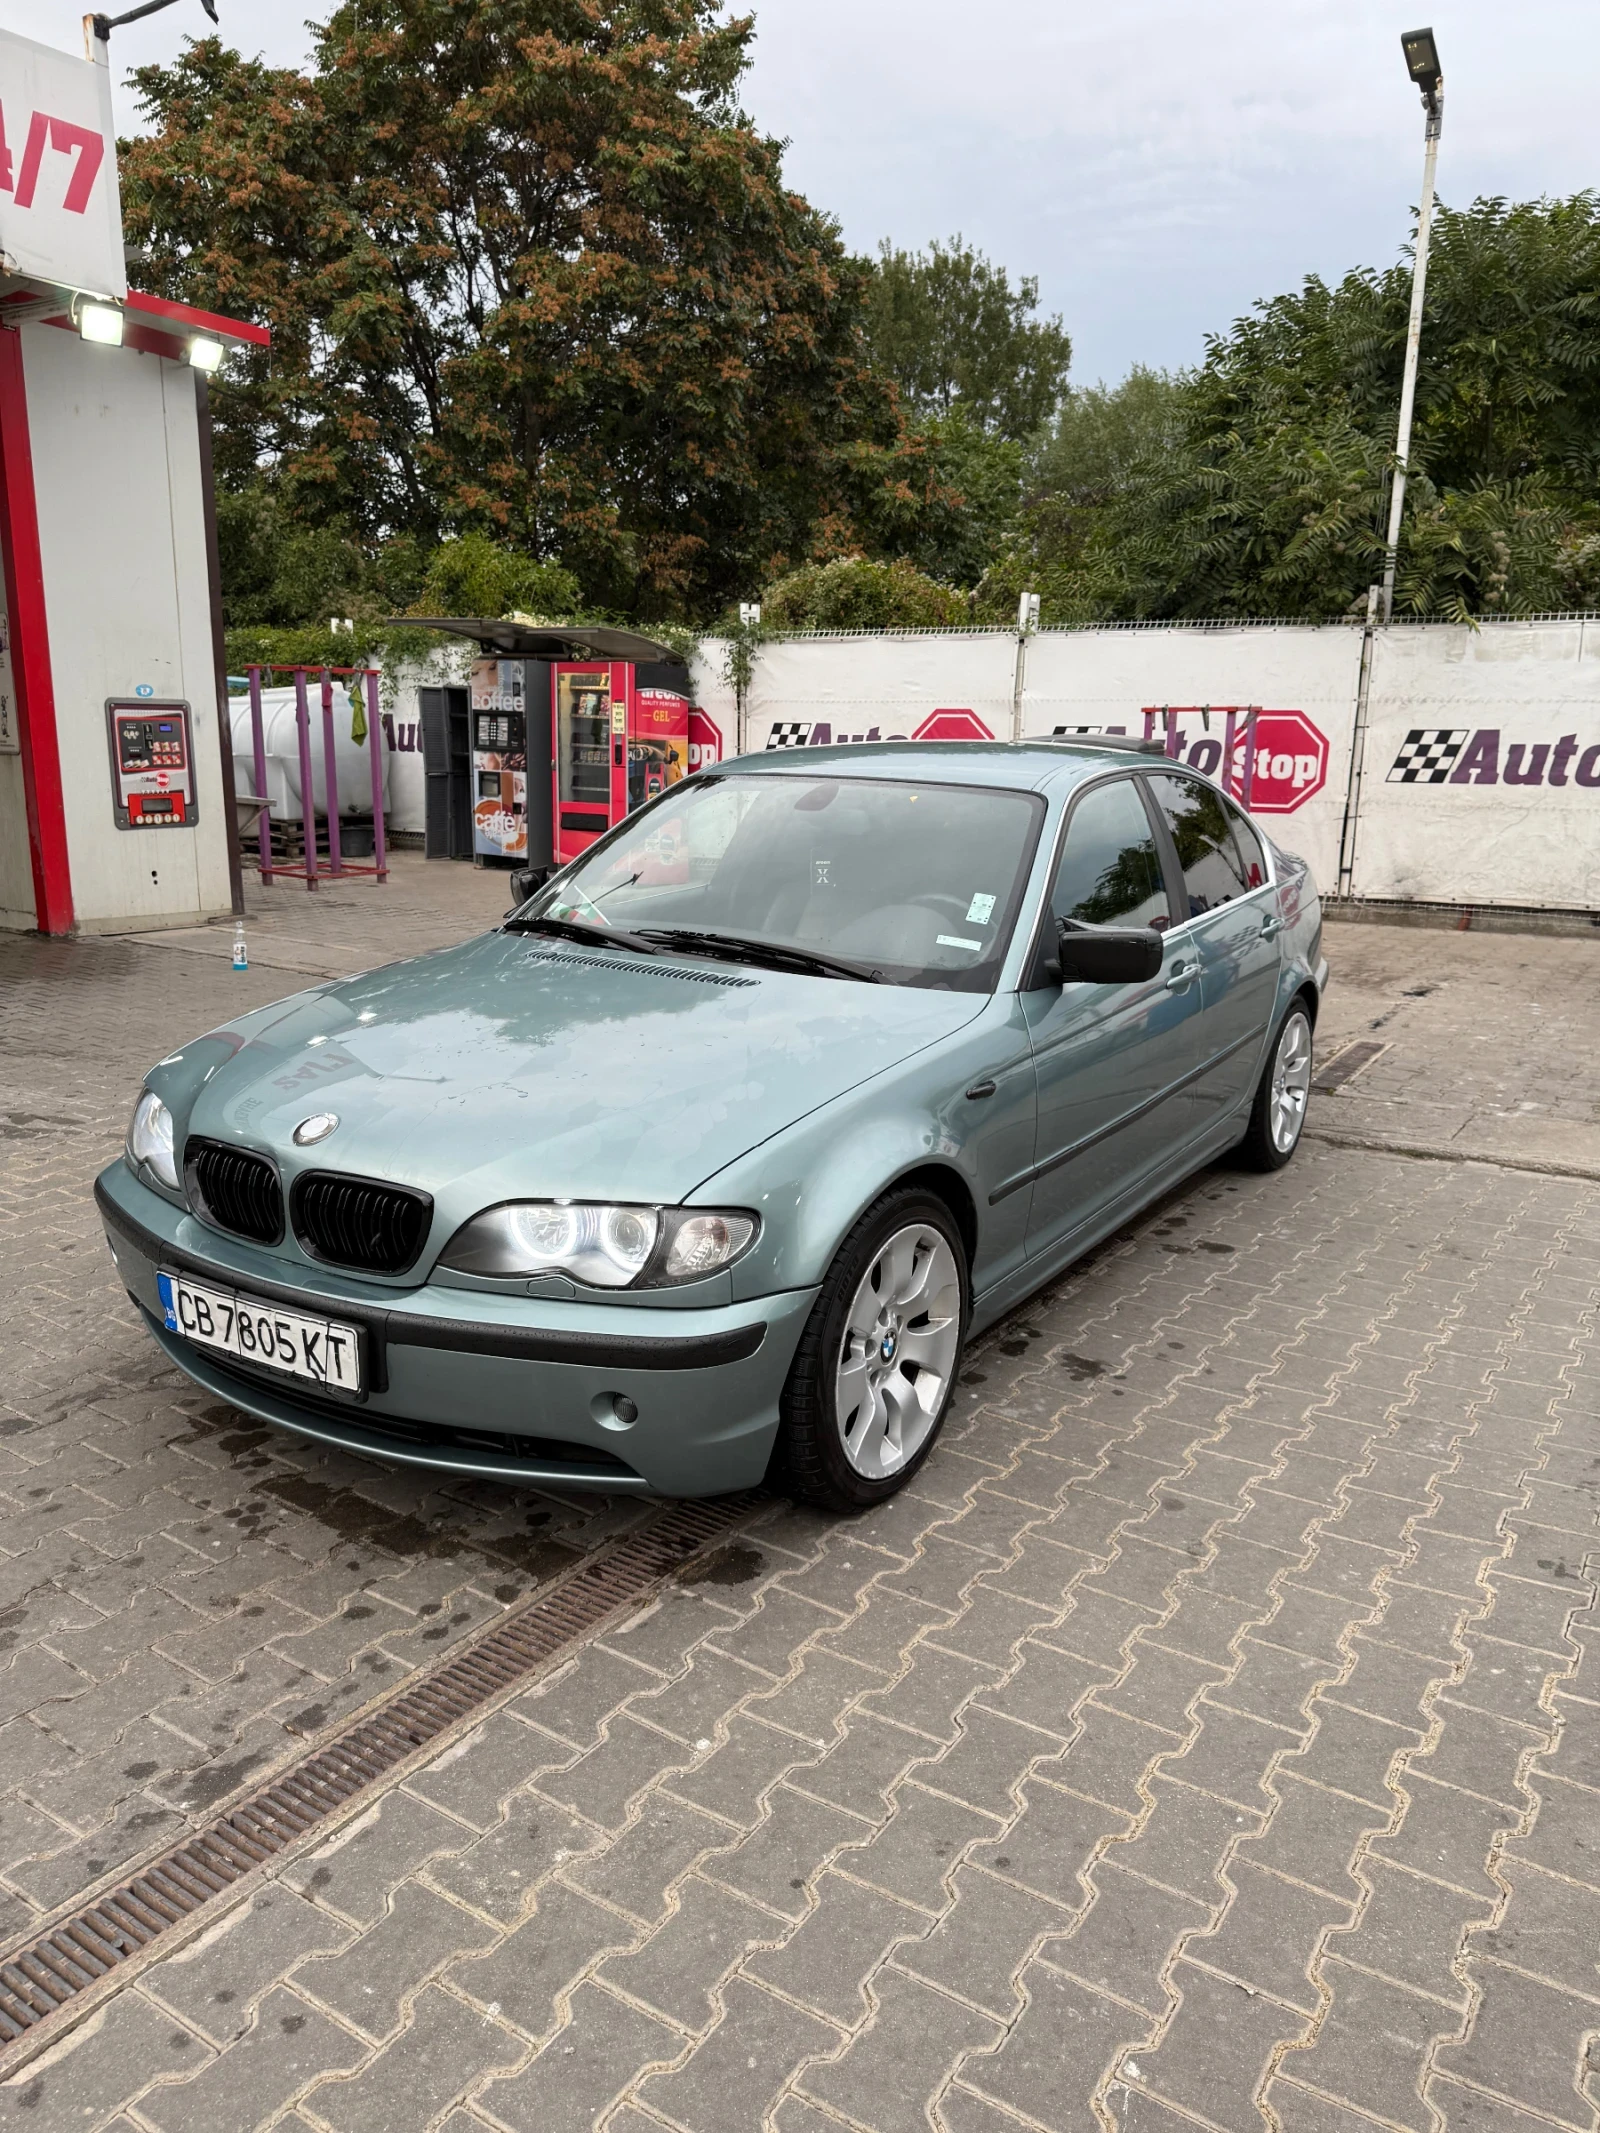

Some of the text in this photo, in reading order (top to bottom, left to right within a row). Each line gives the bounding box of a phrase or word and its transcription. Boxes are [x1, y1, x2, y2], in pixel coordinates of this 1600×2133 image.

[472, 691, 525, 711] coffee
[653, 710, 670, 722] GEL
[1449, 729, 1600, 787] Auto
